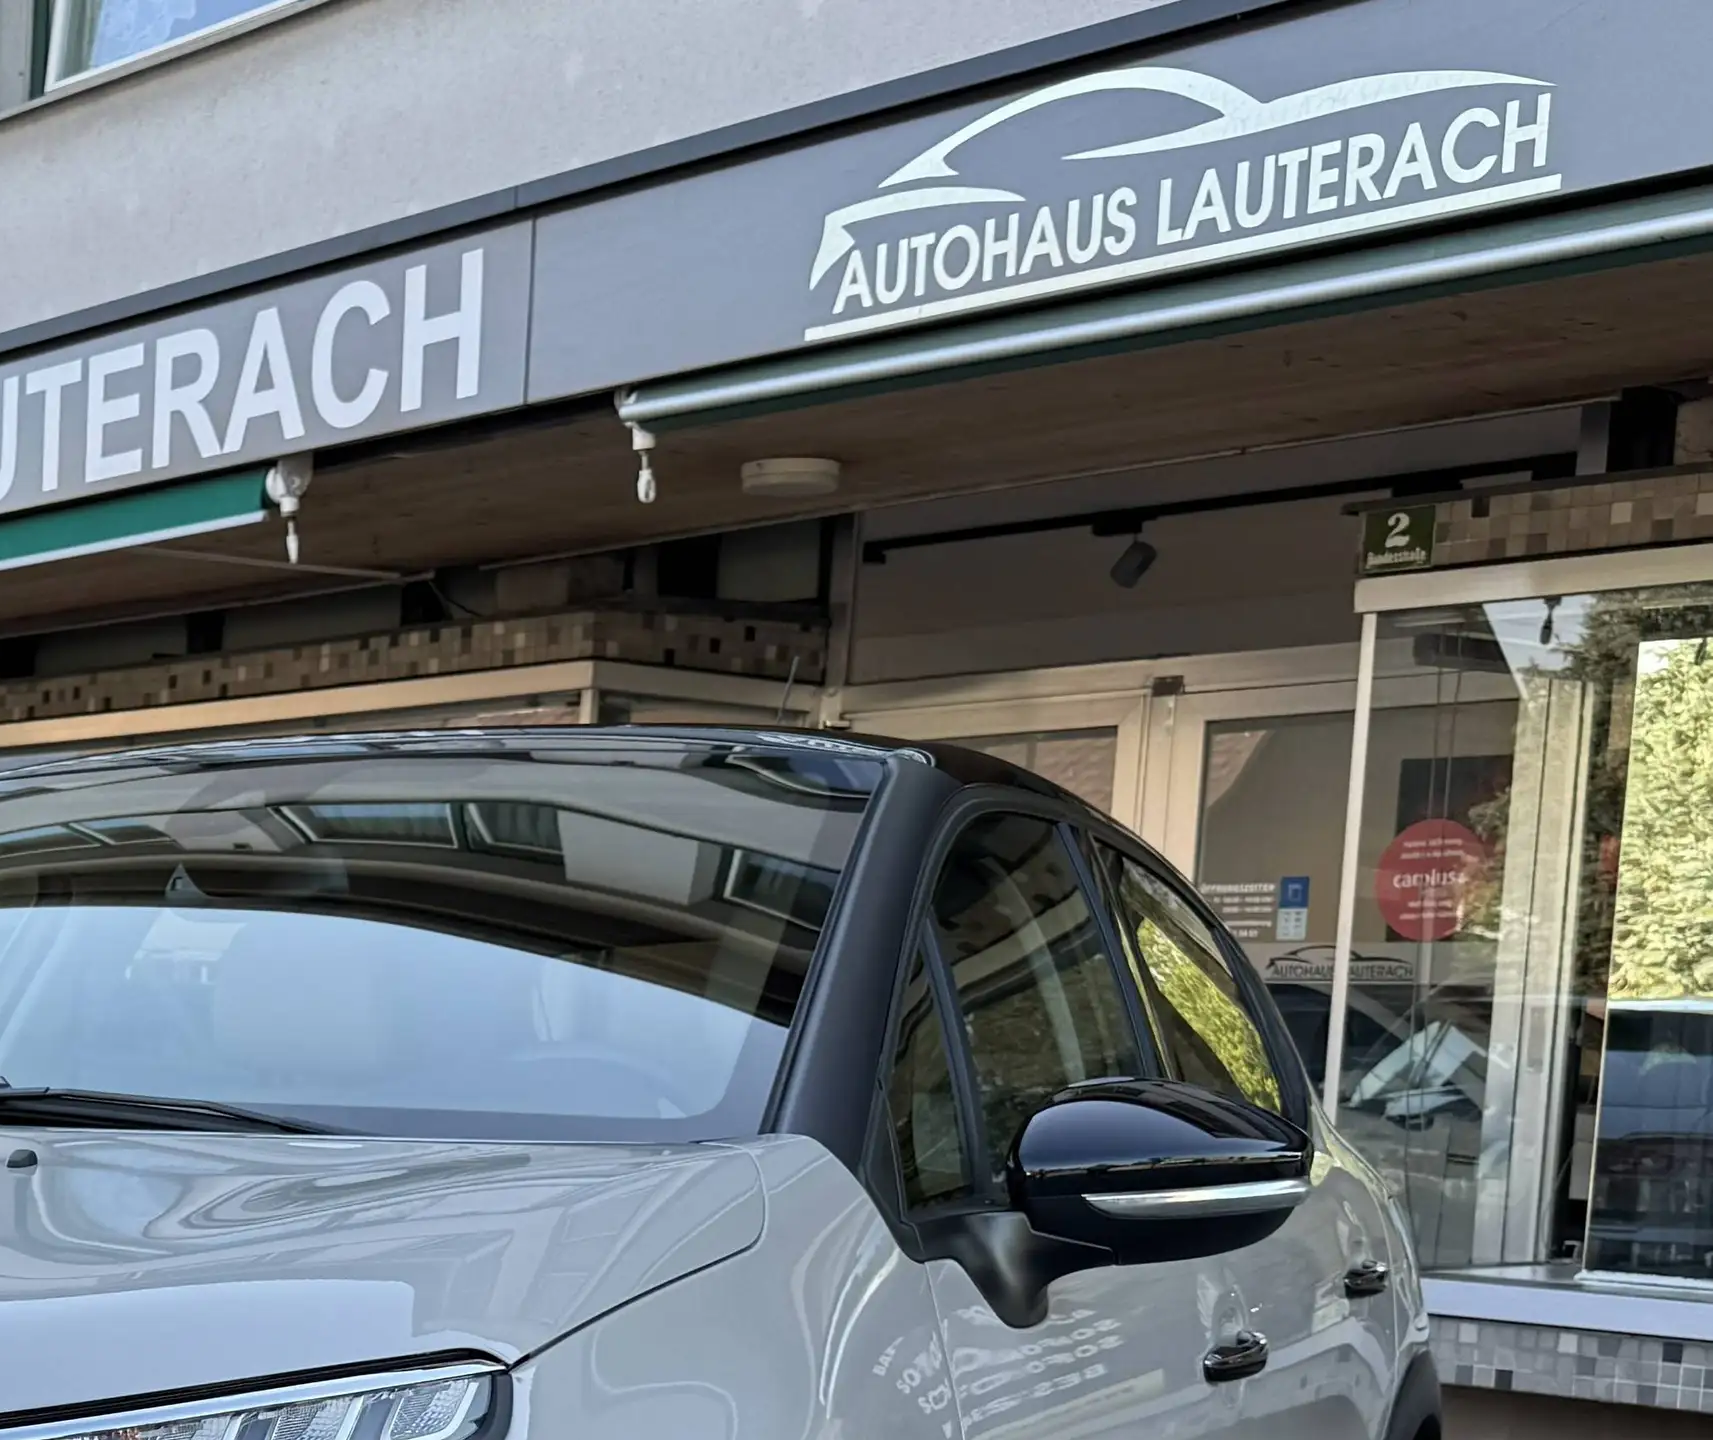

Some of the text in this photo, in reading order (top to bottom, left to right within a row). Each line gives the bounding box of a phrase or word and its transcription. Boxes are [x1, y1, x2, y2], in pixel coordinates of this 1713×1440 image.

[832, 92, 1552, 315] AUTOHAUS LAUTERACH
[1385, 512, 1410, 548] 2
[1349, 964, 1413, 979] AUTERACH
